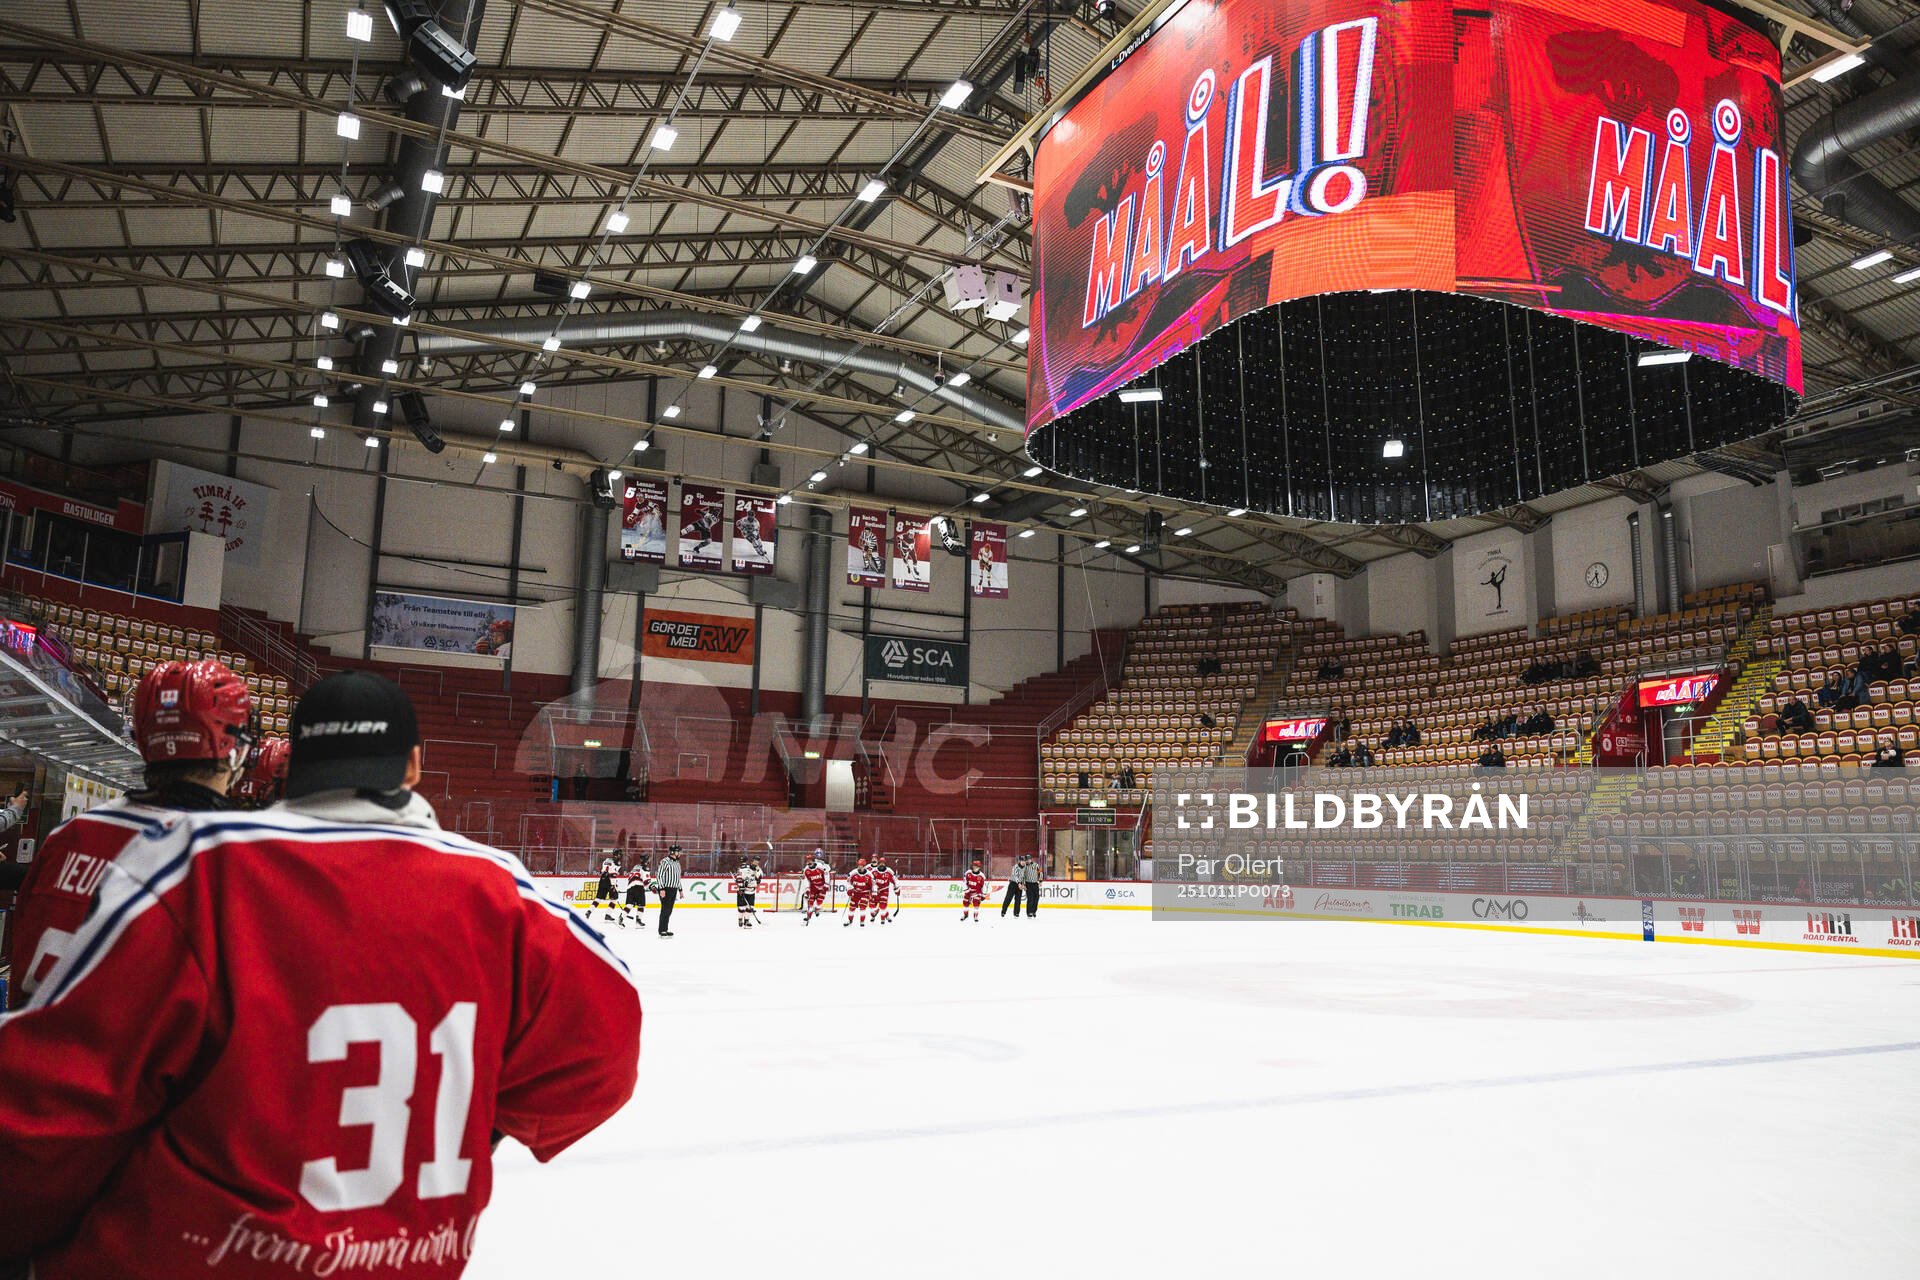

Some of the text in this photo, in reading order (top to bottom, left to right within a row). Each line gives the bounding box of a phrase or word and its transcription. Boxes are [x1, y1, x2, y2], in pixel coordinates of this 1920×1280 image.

[1081, 16, 1377, 329] MÅÅL!
[193, 484, 247, 511] TIMRÅ IK
[684, 494, 694, 506] 8
[736, 500, 752, 512] 24
[63, 502, 115, 526] BASTULOGEN
[851, 515, 860, 527] 11
[896, 521, 904, 532] 8
[651, 619, 748, 653] GÖR DET RW
[670, 636, 697, 648] MED
[439, 639, 460, 649] SCA
[912, 648, 954, 667] SCA
[312, 720, 389, 735] BAUER
[166, 741, 177, 756] 9
[1117, 890, 1135, 898] SCA
[1263, 890, 1295, 910] ABB
[1390, 903, 1444, 919] TIRAB
[1472, 897, 1528, 920] CAMO
[1803, 933, 1859, 943] ROAD RENTAL
[1887, 938, 1912, 946] ROAD
[300, 1001, 478, 1213] 31
